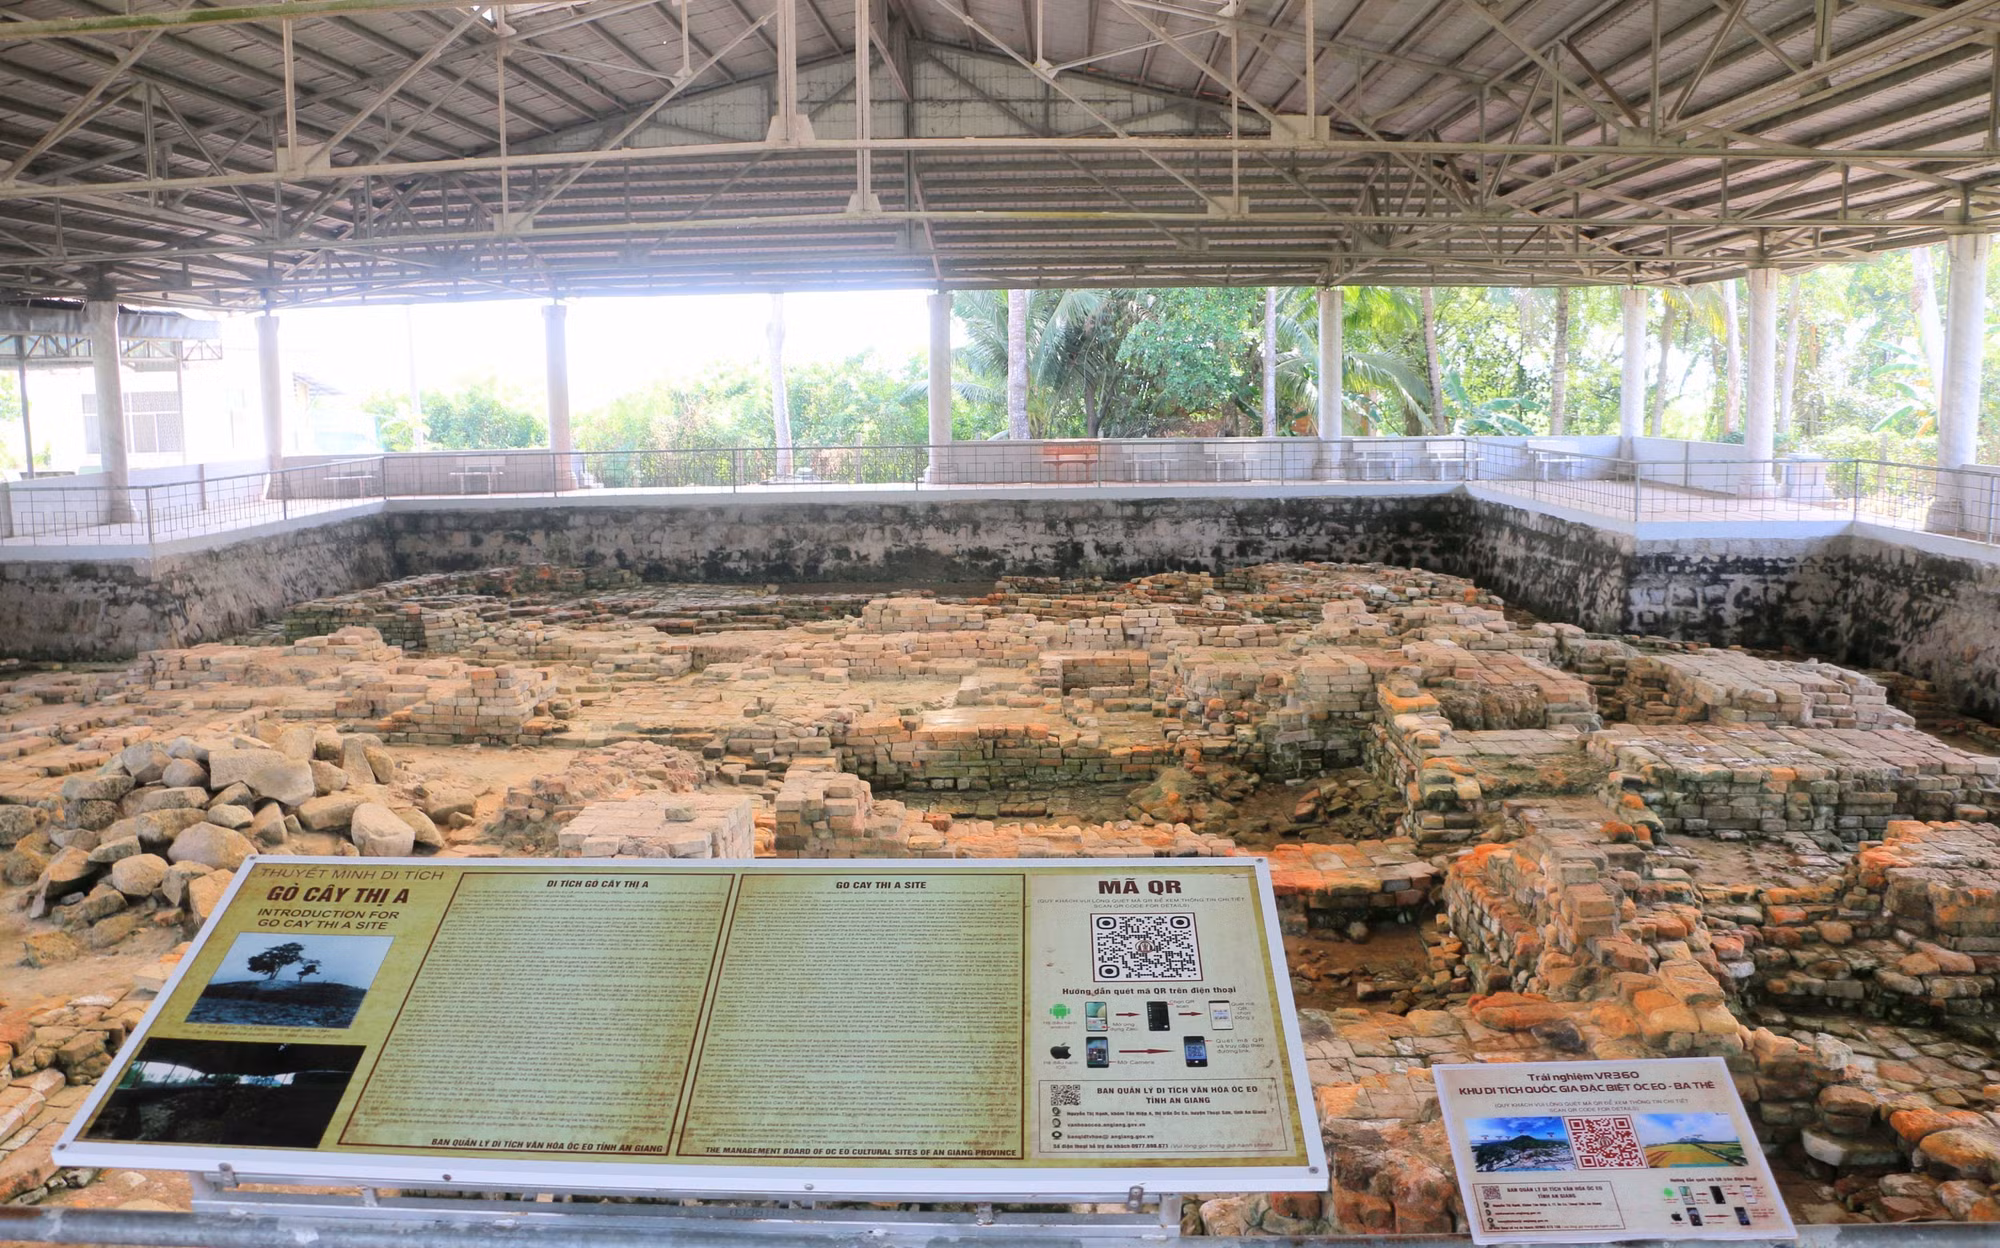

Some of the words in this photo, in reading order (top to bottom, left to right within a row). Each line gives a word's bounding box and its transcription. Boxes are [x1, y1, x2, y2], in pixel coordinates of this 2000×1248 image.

[262, 866, 328, 878] THUYẾT
[332, 870, 376, 879] MINH
[381, 870, 399, 880] DI
[405, 869, 444, 880] TÍCH
[585, 879, 598, 887] GÒ
[601, 880, 621, 888] CÂY
[624, 881, 640, 889] THỊ
[1098, 878, 1139, 894] MÃ
[1148, 880, 1182, 895] QR
[267, 883, 300, 901] GÒ
[303, 884, 350, 902] CÂY
[354, 888, 390, 906] THỊ
[392, 888, 410, 904] A
[258, 908, 366, 918] INTRODUCTION
[369, 911, 399, 920] FOR
[258, 919, 280, 927] GO
[283, 920, 313, 928] CAY
[356, 922, 388, 930] SITE
[1213, 986, 1236, 994] thoại
[1552, 1073, 1593, 1082] nghiệm
[1594, 1071, 1639, 1080] VR360
[1168, 1086, 1188, 1094] TÍCH
[1497, 1086, 1523, 1094] TÍCH
[1526, 1084, 1557, 1094] QUỐC
[1580, 1085, 1605, 1093] ĐẶC
[1606, 1083, 1630, 1092] BIỆT
[1692, 1081, 1715, 1089] THÊ
[452, 1138, 477, 1146] QUẢN
[504, 1140, 524, 1148] TÍCH
[597, 1142, 616, 1151] TỈNH
